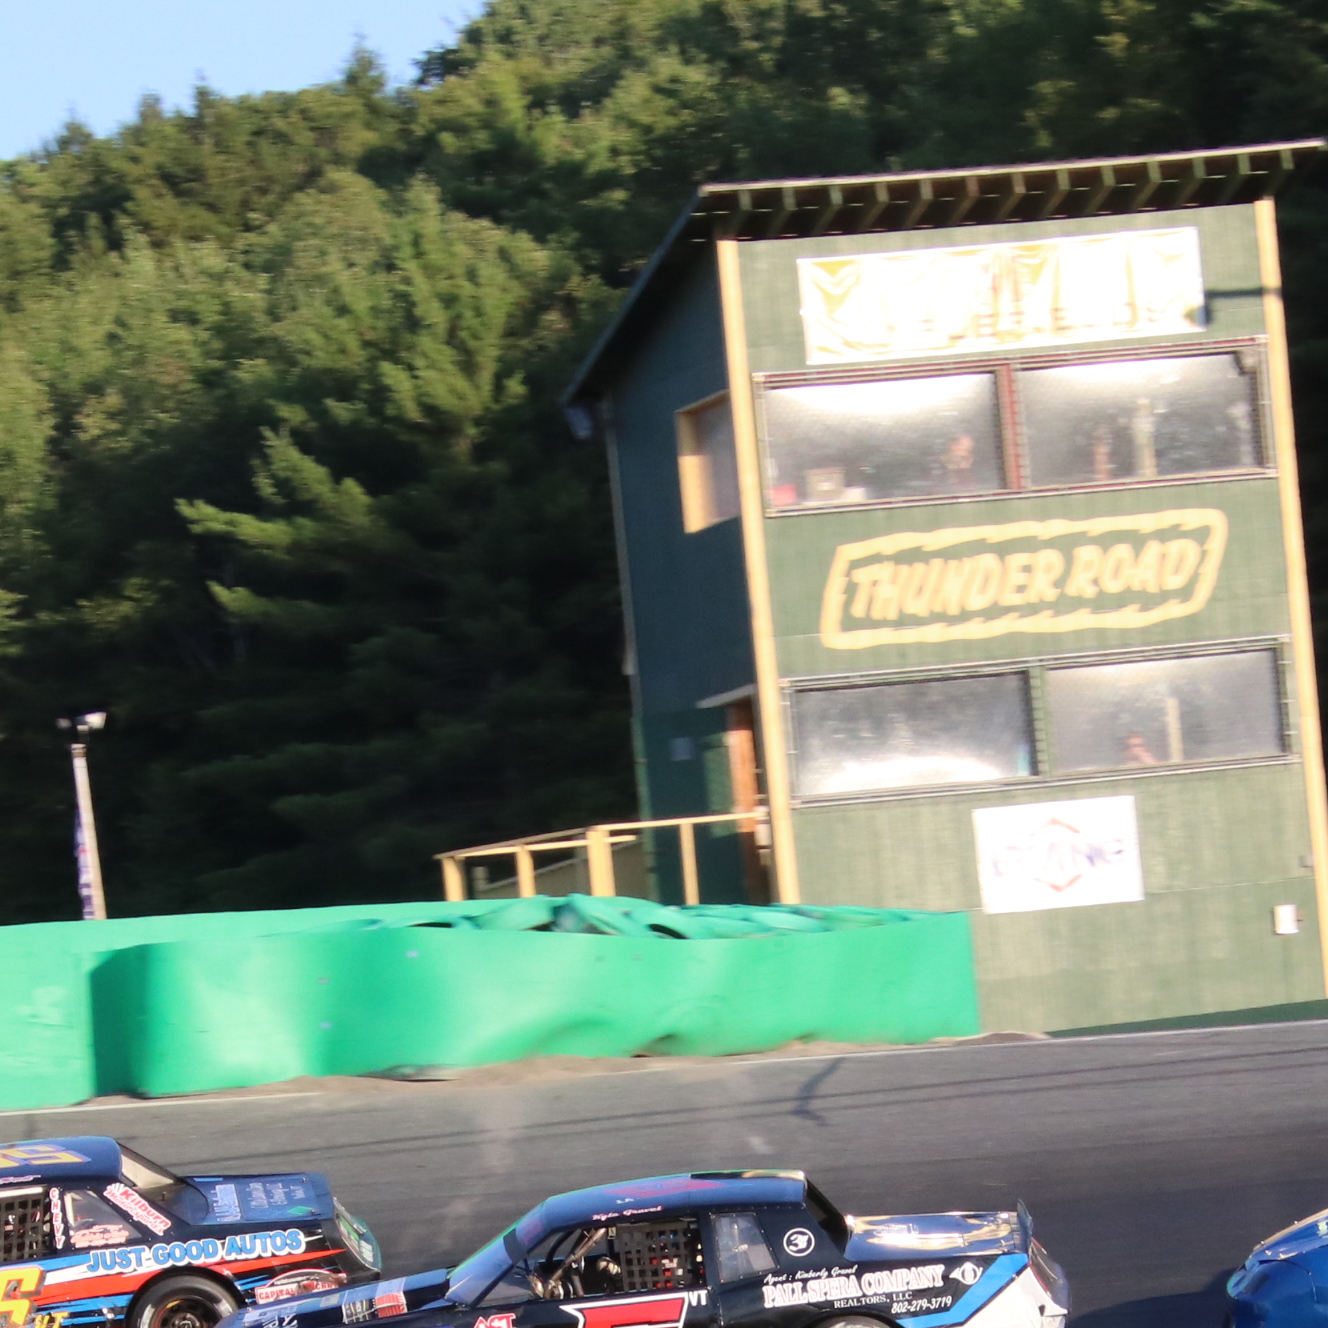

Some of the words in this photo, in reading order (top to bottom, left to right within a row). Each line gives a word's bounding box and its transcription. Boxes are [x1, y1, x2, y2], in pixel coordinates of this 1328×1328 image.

[850, 547, 1066, 620] THUNDER
[1064, 538, 1202, 598] ROAD
[50, 1187, 64, 1249] CHEVY
[119, 1188, 171, 1229] Kilburn
[86, 1246, 146, 1274] JUST
[152, 1238, 219, 1266] GOOD
[225, 1228, 304, 1258] AUTOS
[763, 1273, 787, 1285] Agent
[830, 1263, 859, 1276] Gravel
[763, 1282, 808, 1308] PALL
[807, 1277, 862, 1304] SPERA
[862, 1264, 945, 1295] COMPANY
[689, 1289, 708, 1306] VT
[891, 1295, 953, 1313] 802-279-3719
[892, 1291, 913, 1302] LLC
